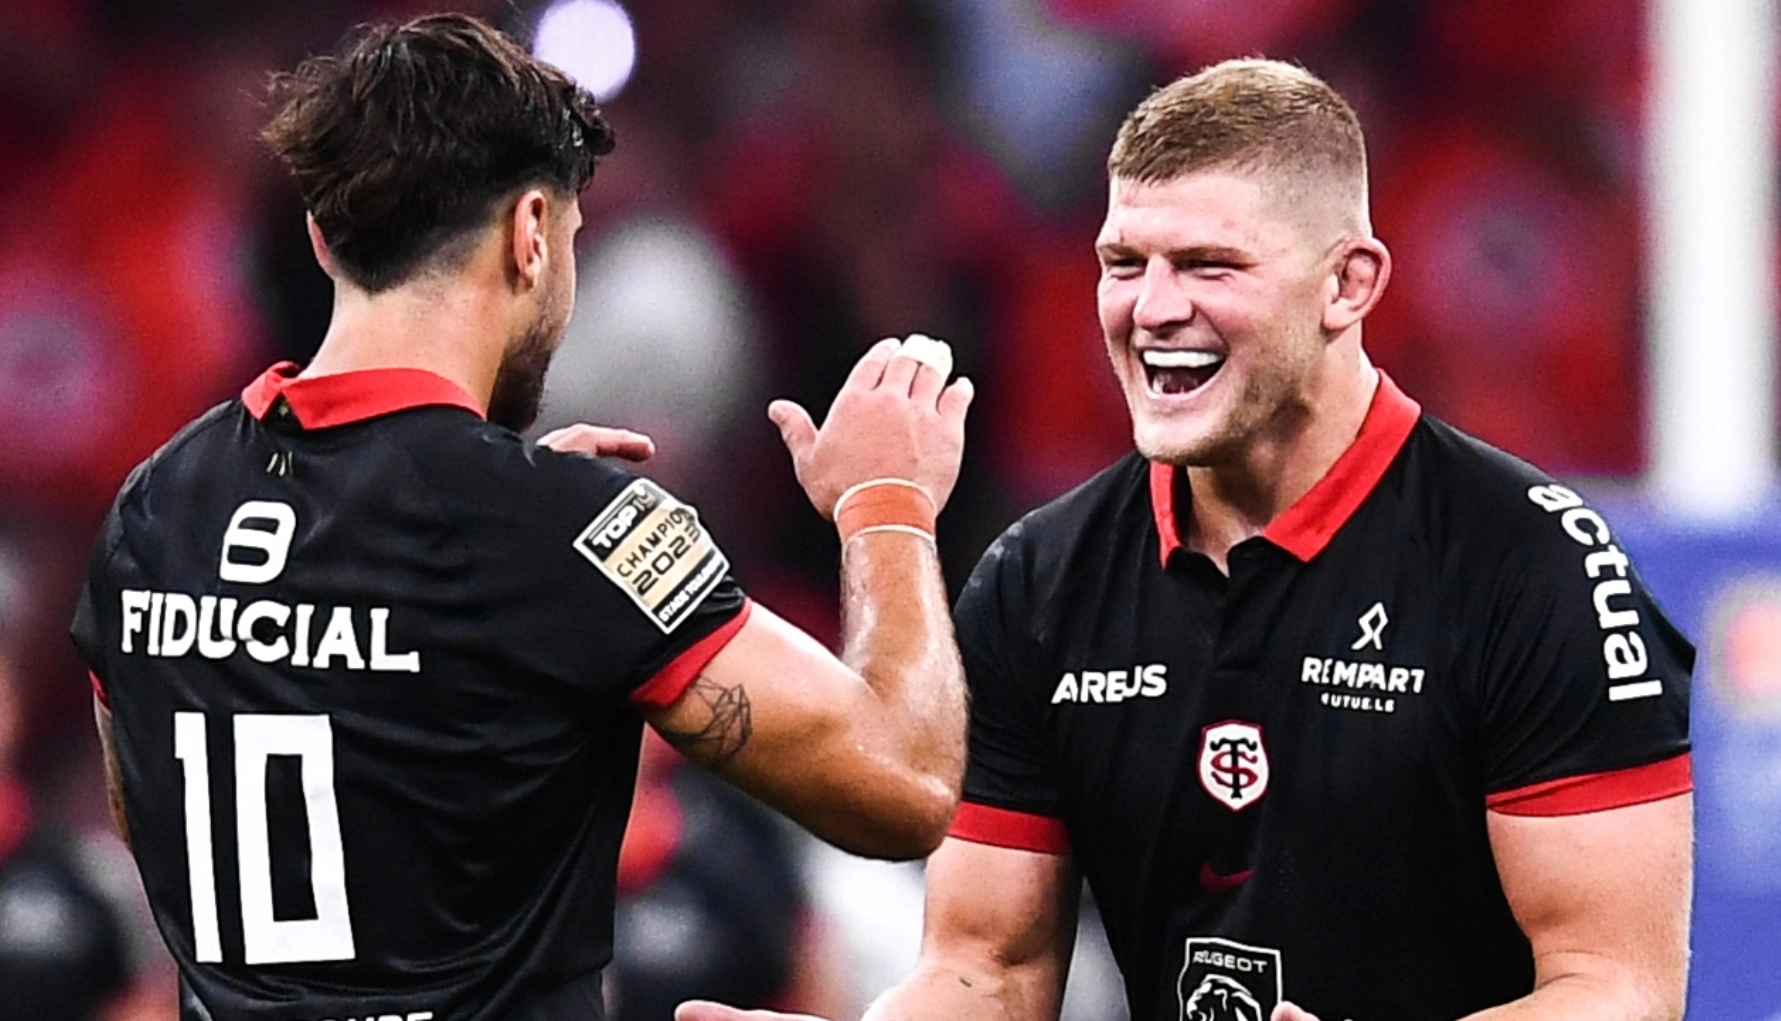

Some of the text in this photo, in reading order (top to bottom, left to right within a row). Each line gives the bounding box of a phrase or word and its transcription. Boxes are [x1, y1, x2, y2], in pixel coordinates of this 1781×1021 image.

[617, 507, 698, 577] CHAMPIO
[121, 590, 420, 672] FIDUCIAL
[1528, 484, 1662, 701] actual
[1301, 656, 1425, 694] REMPART
[174, 711, 356, 965] 10
